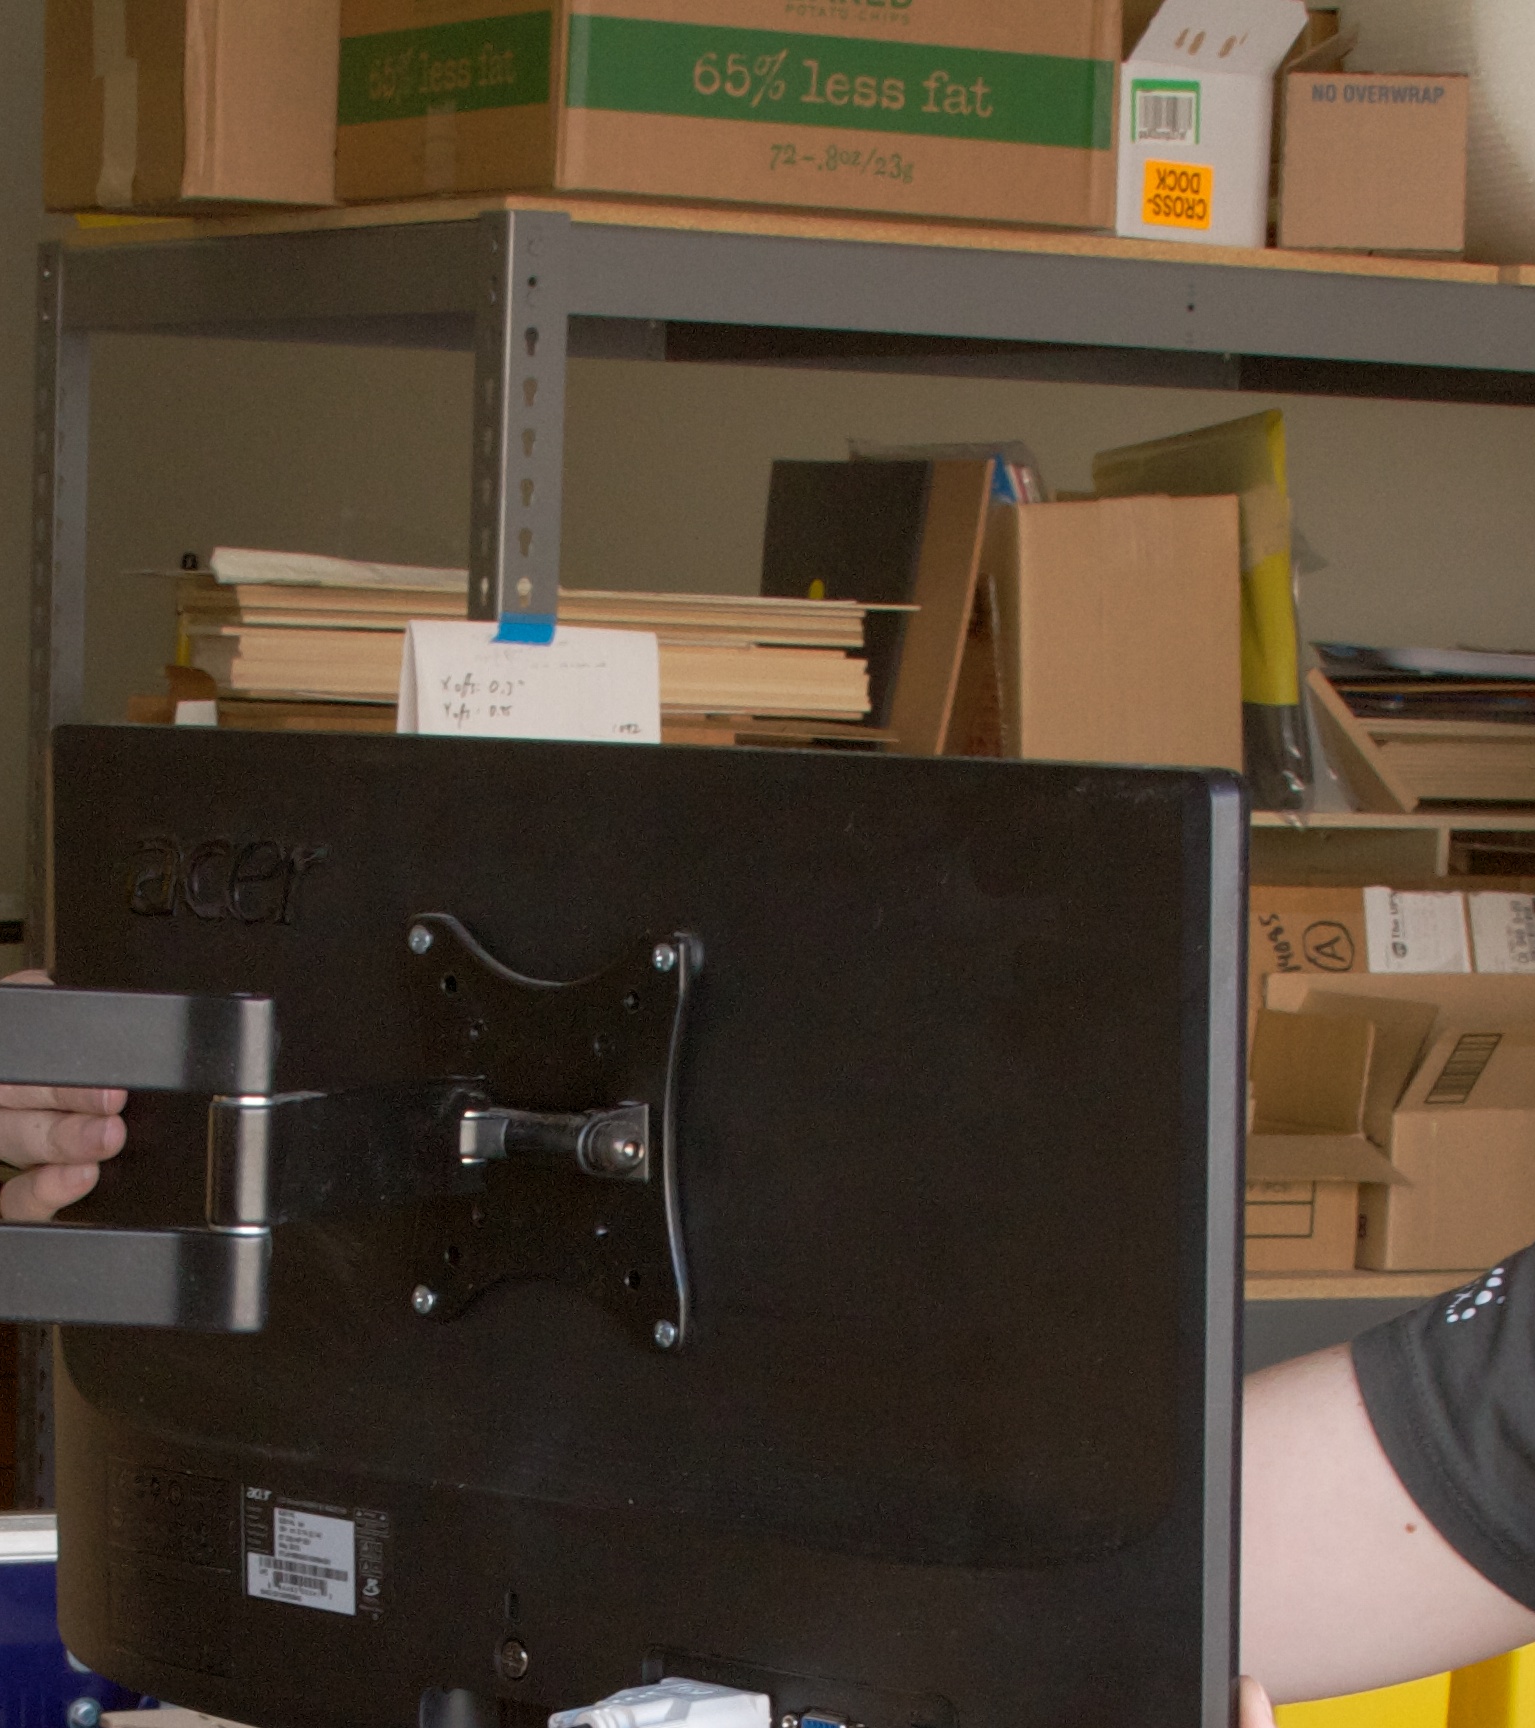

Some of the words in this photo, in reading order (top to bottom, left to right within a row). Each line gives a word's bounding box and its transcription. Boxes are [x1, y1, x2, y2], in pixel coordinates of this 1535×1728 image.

[692, 47, 789, 108] 65%
[800, 58, 906, 110] less
[920, 70, 994, 118] fat
[1311, 83, 1338, 103] NO
[1342, 85, 1446, 105] OVERWRAP
[1156, 168, 1201, 194] DOCK
[1147, 193, 1207, 221] CROSS-
[126, 836, 331, 924] acer
